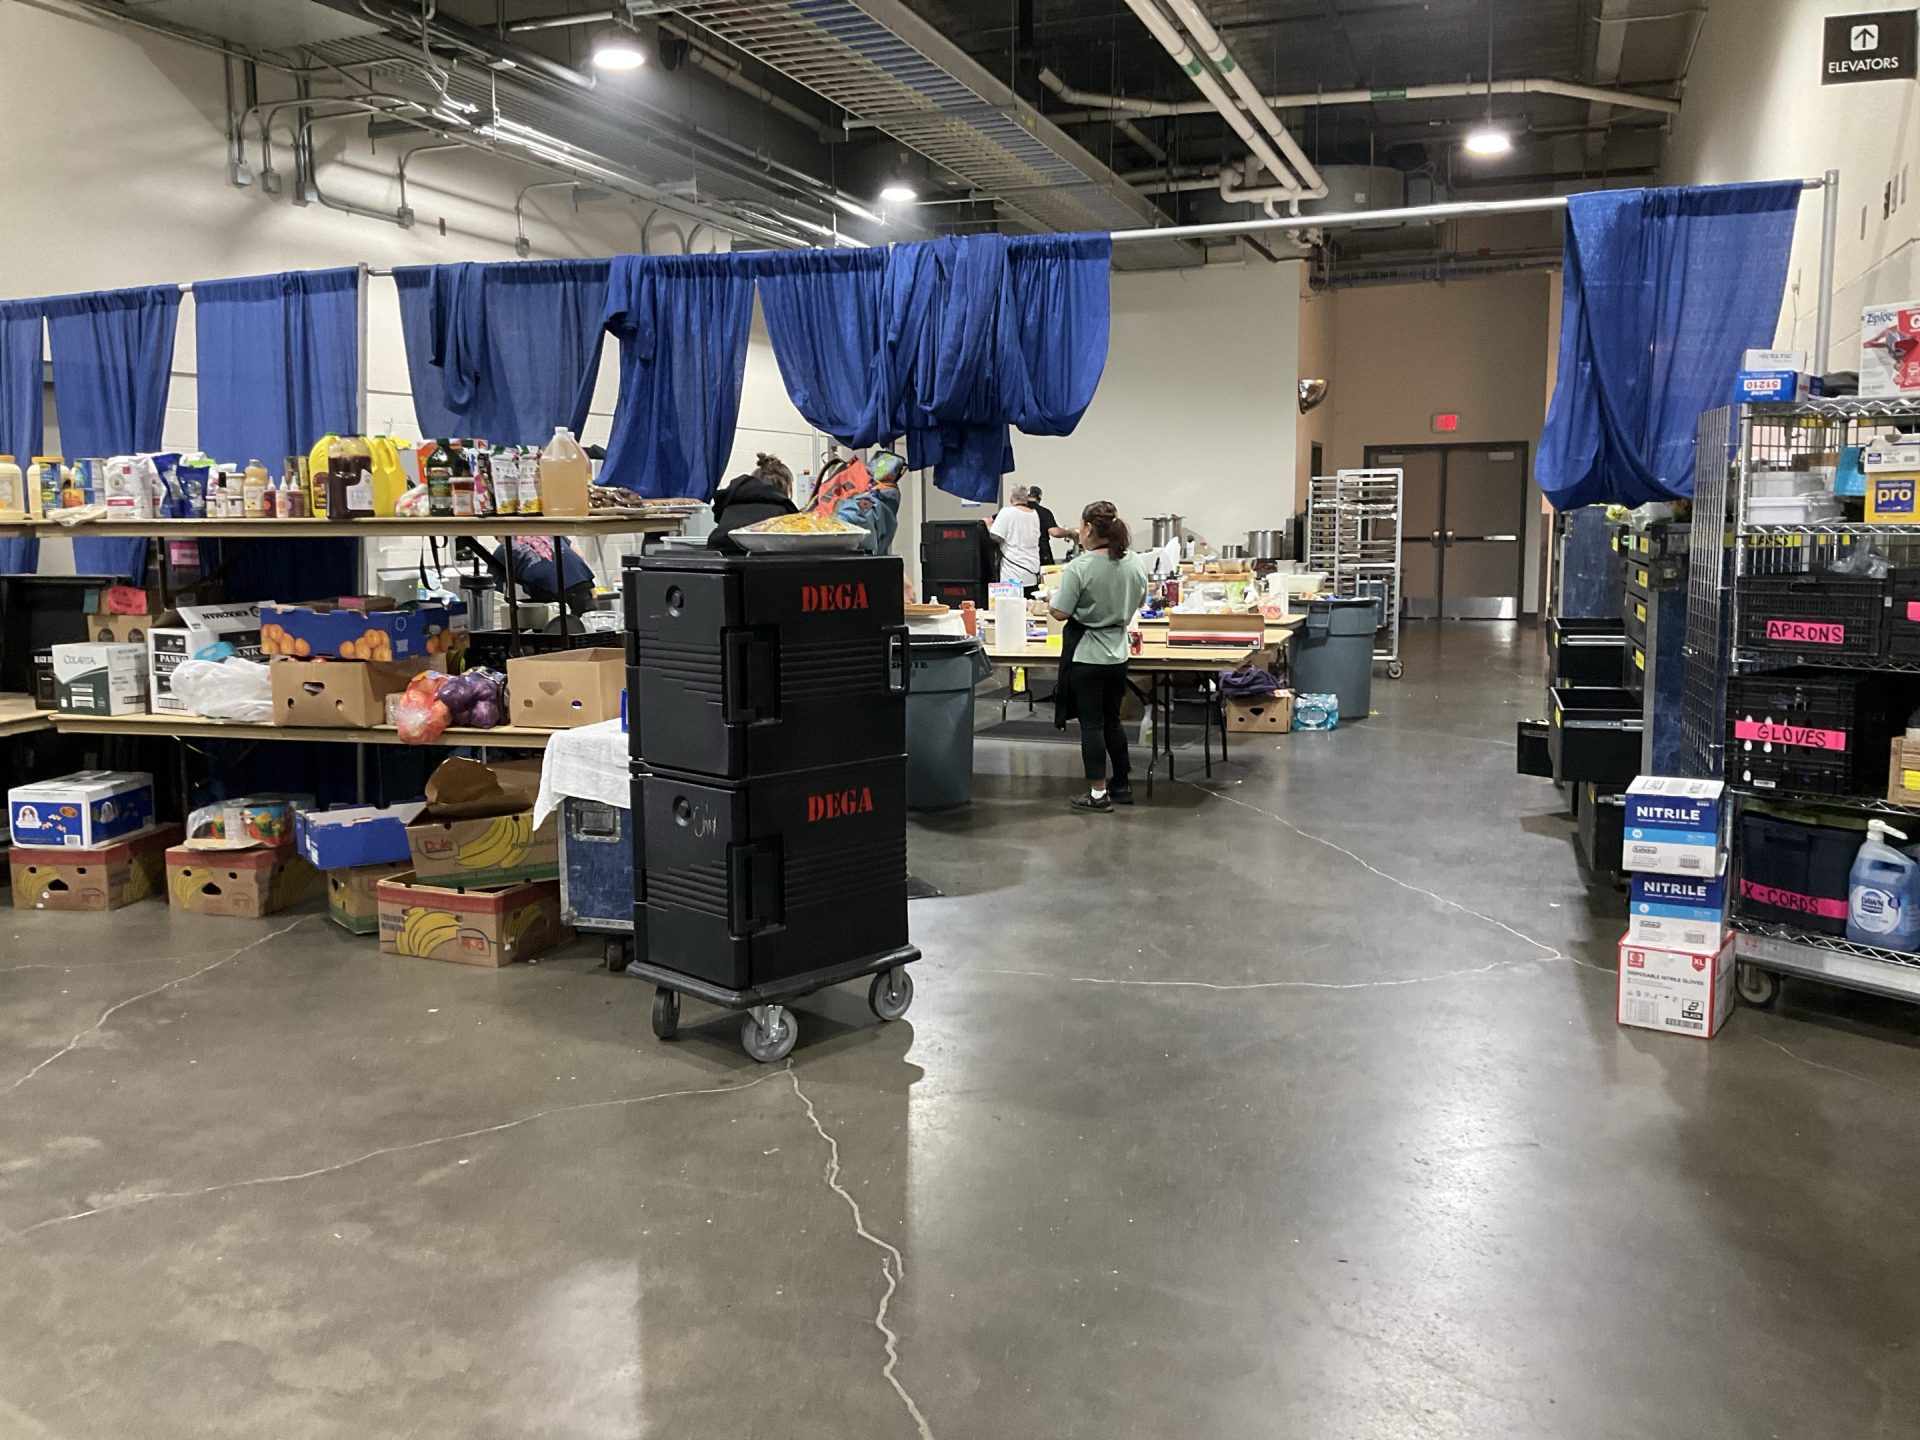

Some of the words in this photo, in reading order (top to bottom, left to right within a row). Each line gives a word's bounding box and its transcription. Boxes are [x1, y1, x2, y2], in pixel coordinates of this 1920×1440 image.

[1828, 57, 1899, 73] ELEVATORS
[1866, 311, 1894, 326] Ziploc
[1746, 381, 1779, 389] 51210
[1877, 488, 1912, 504] pro
[801, 583, 869, 612] DEGA
[202, 610, 250, 620] KIKKOMAN
[1768, 622, 1843, 643] APRONS
[63, 654, 97, 665] COLAVITA
[160, 654, 189, 663] PANKO
[1757, 724, 1827, 748] GLOVES
[808, 787, 874, 822] DEGA
[1636, 805, 1701, 821] NITRILE
[424, 838, 453, 851] Dole
[1643, 881, 1707, 897] NITRILE
[1862, 896, 1884, 907] DAWN
[1693, 958, 1704, 966] XL
[1627, 970, 1660, 980] DISPOSABLE
[1661, 975, 1681, 983] NITRILE
[1682, 978, 1704, 986] GLOVES
